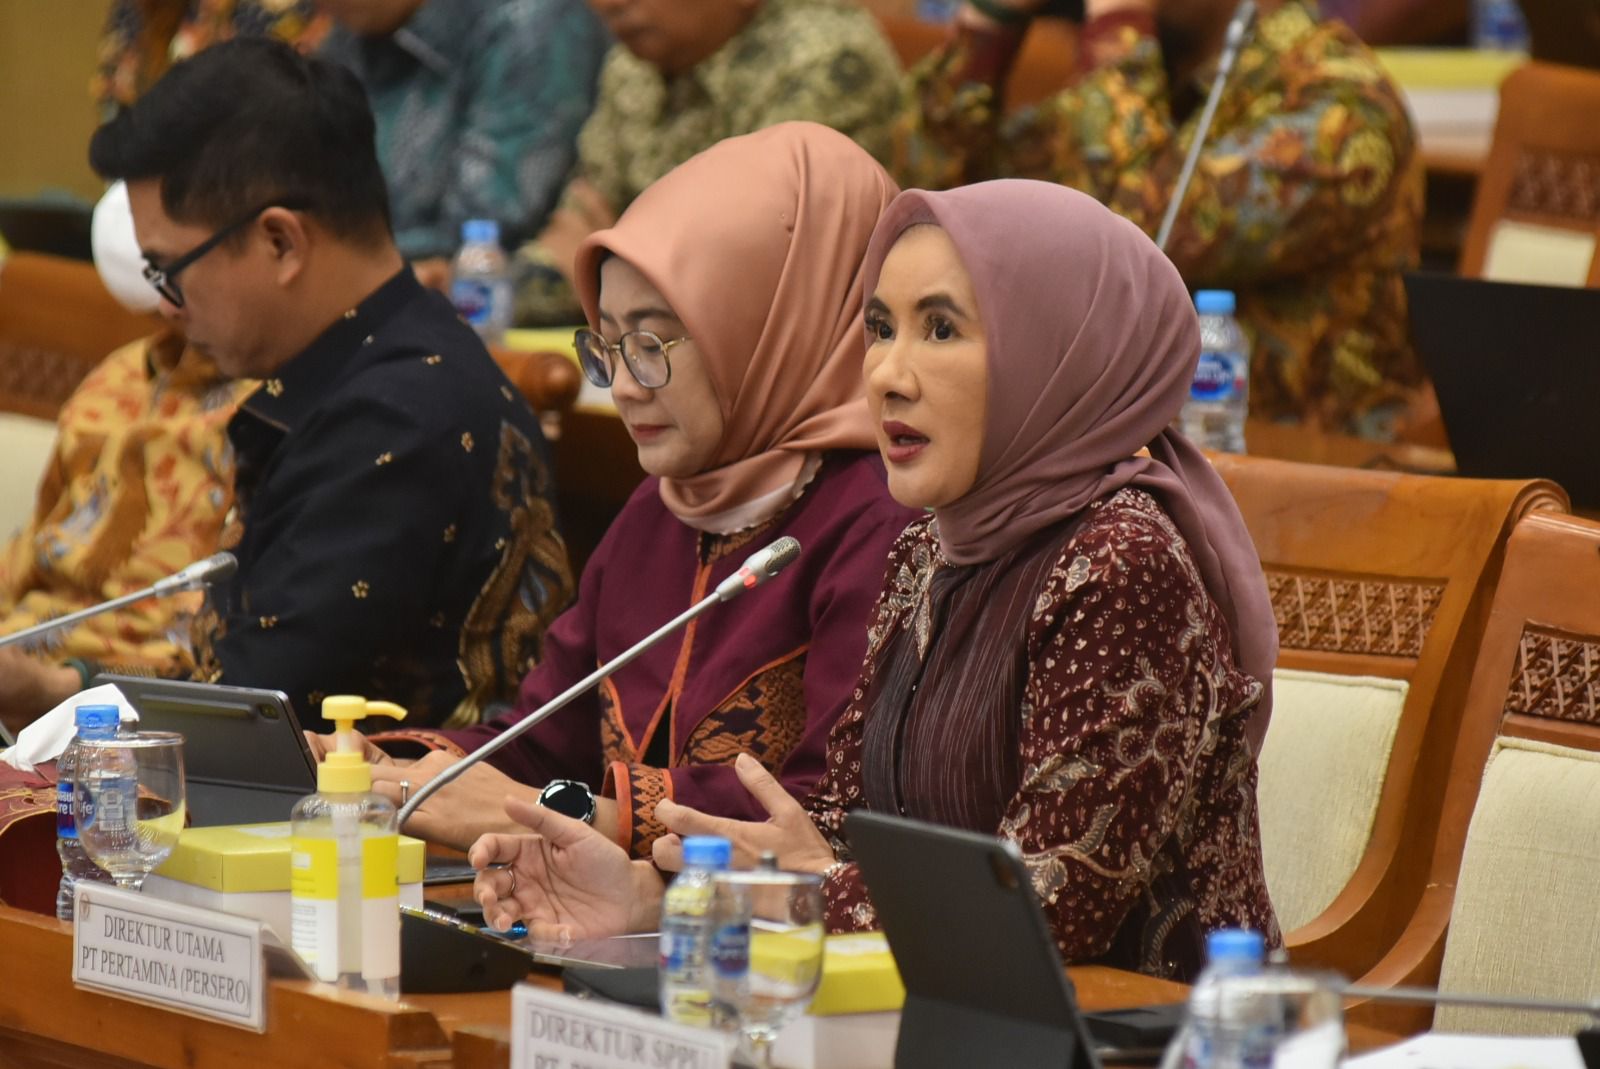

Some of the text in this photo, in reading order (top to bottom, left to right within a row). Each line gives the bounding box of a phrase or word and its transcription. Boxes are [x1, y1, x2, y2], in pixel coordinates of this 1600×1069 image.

[104, 915, 225, 963] DIREKTUR UTAMA
[82, 946, 251, 1009] PT PERTAMINA (PERSERO)
[530, 1011, 647, 1065] DIREKTUR
